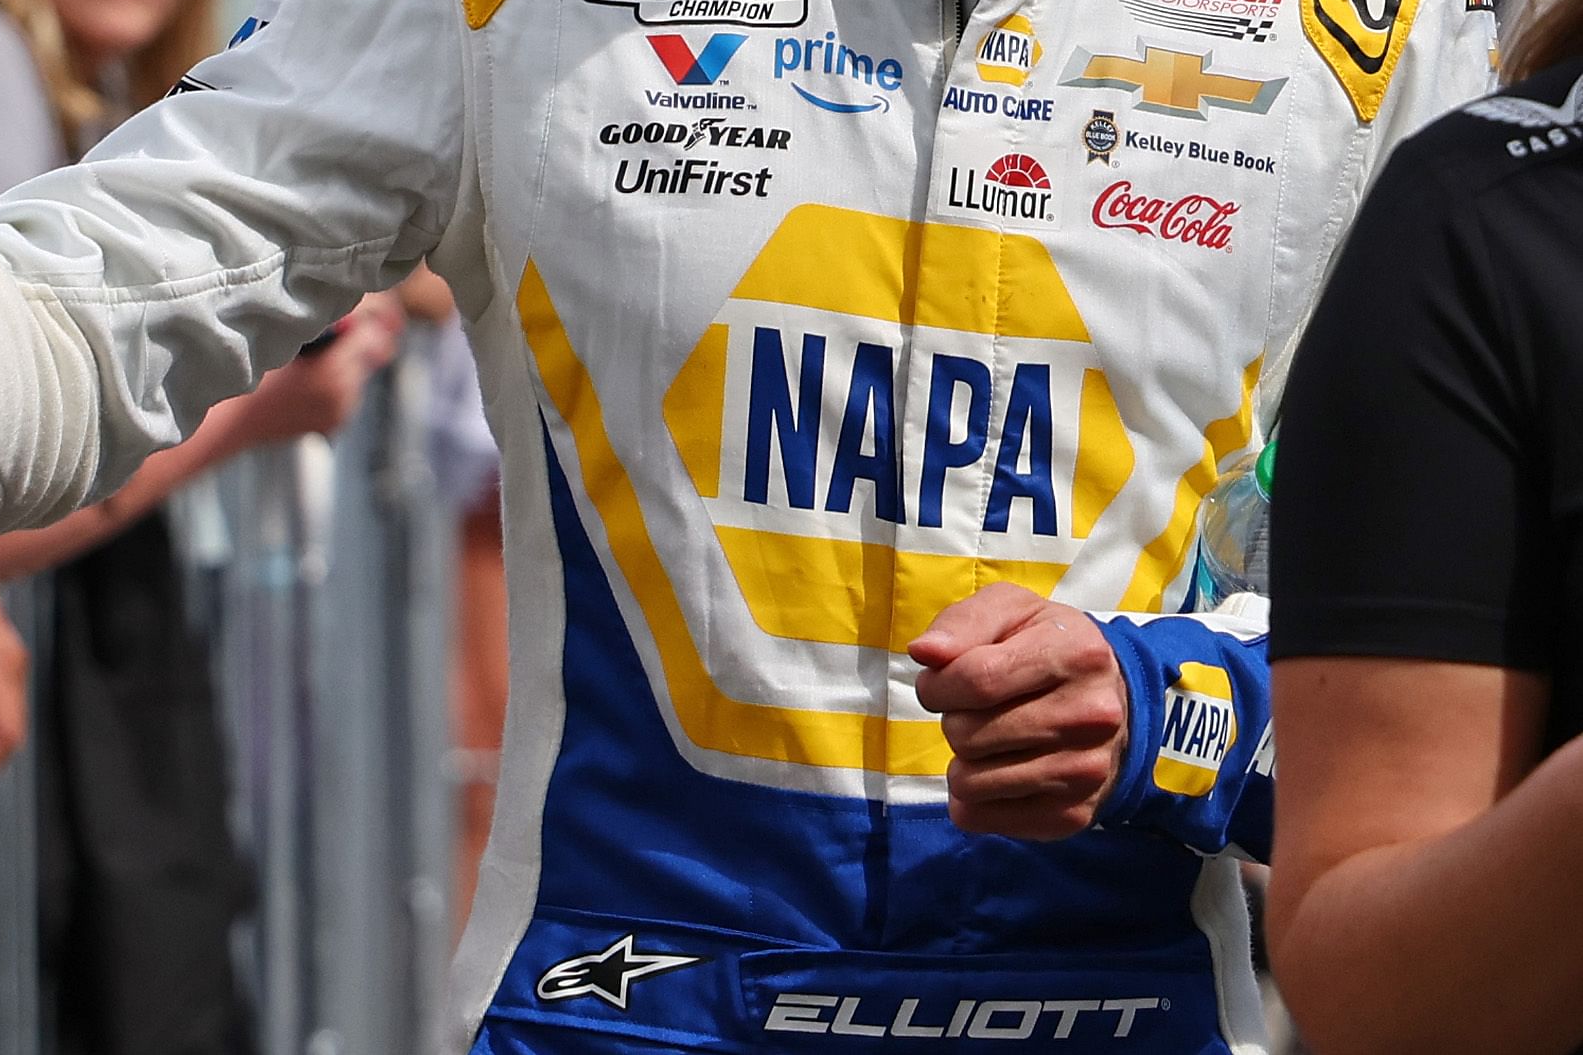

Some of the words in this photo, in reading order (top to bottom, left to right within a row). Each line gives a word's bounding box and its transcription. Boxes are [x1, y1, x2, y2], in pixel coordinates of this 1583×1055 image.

[669, 0, 775, 20] CHAMPION
[774, 31, 903, 91] prime
[981, 31, 1030, 67] NAPA
[645, 89, 746, 110] Valvoline
[943, 87, 998, 114] AUTO
[1002, 95, 1054, 122] CARE
[1125, 130, 1185, 158] Kelley
[1188, 142, 1230, 164] Blue
[1233, 150, 1276, 174] Book
[615, 159, 773, 197] UniFirst
[948, 167, 1051, 220] LLumar
[1092, 180, 1241, 249] Coca-Cola
[743, 326, 1058, 538] NAPA
[1162, 695, 1229, 762] NAPA
[764, 992, 1159, 1040] ELLIOTT
